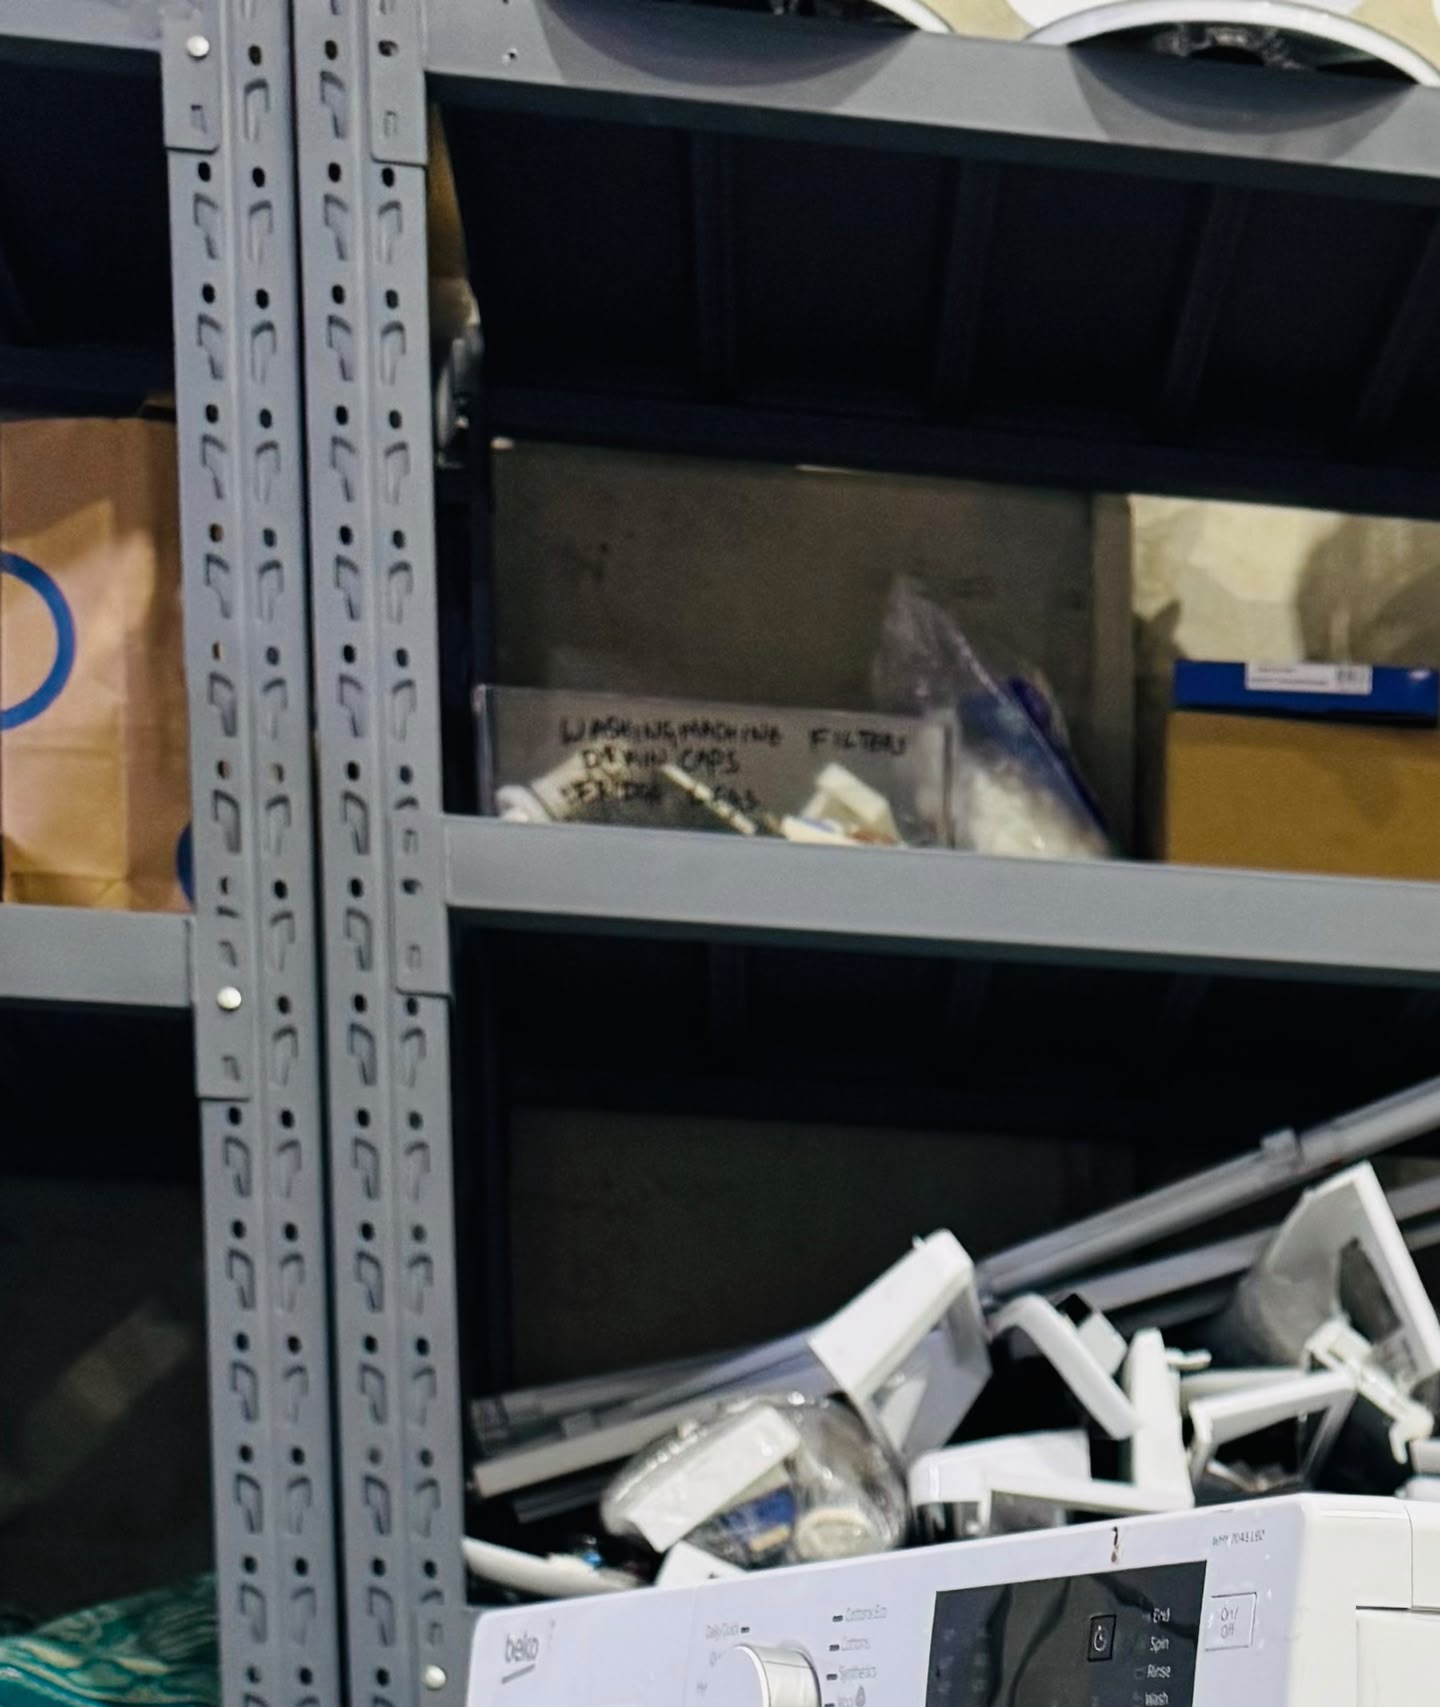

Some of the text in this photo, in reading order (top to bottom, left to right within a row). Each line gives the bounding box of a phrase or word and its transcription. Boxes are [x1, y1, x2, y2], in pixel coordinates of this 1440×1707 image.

[504, 1633, 539, 1664] beko
[1150, 1637, 1169, 1653] Spin
[1147, 1663, 1171, 1678] Rinse
[1145, 1691, 1169, 1706] Wash
